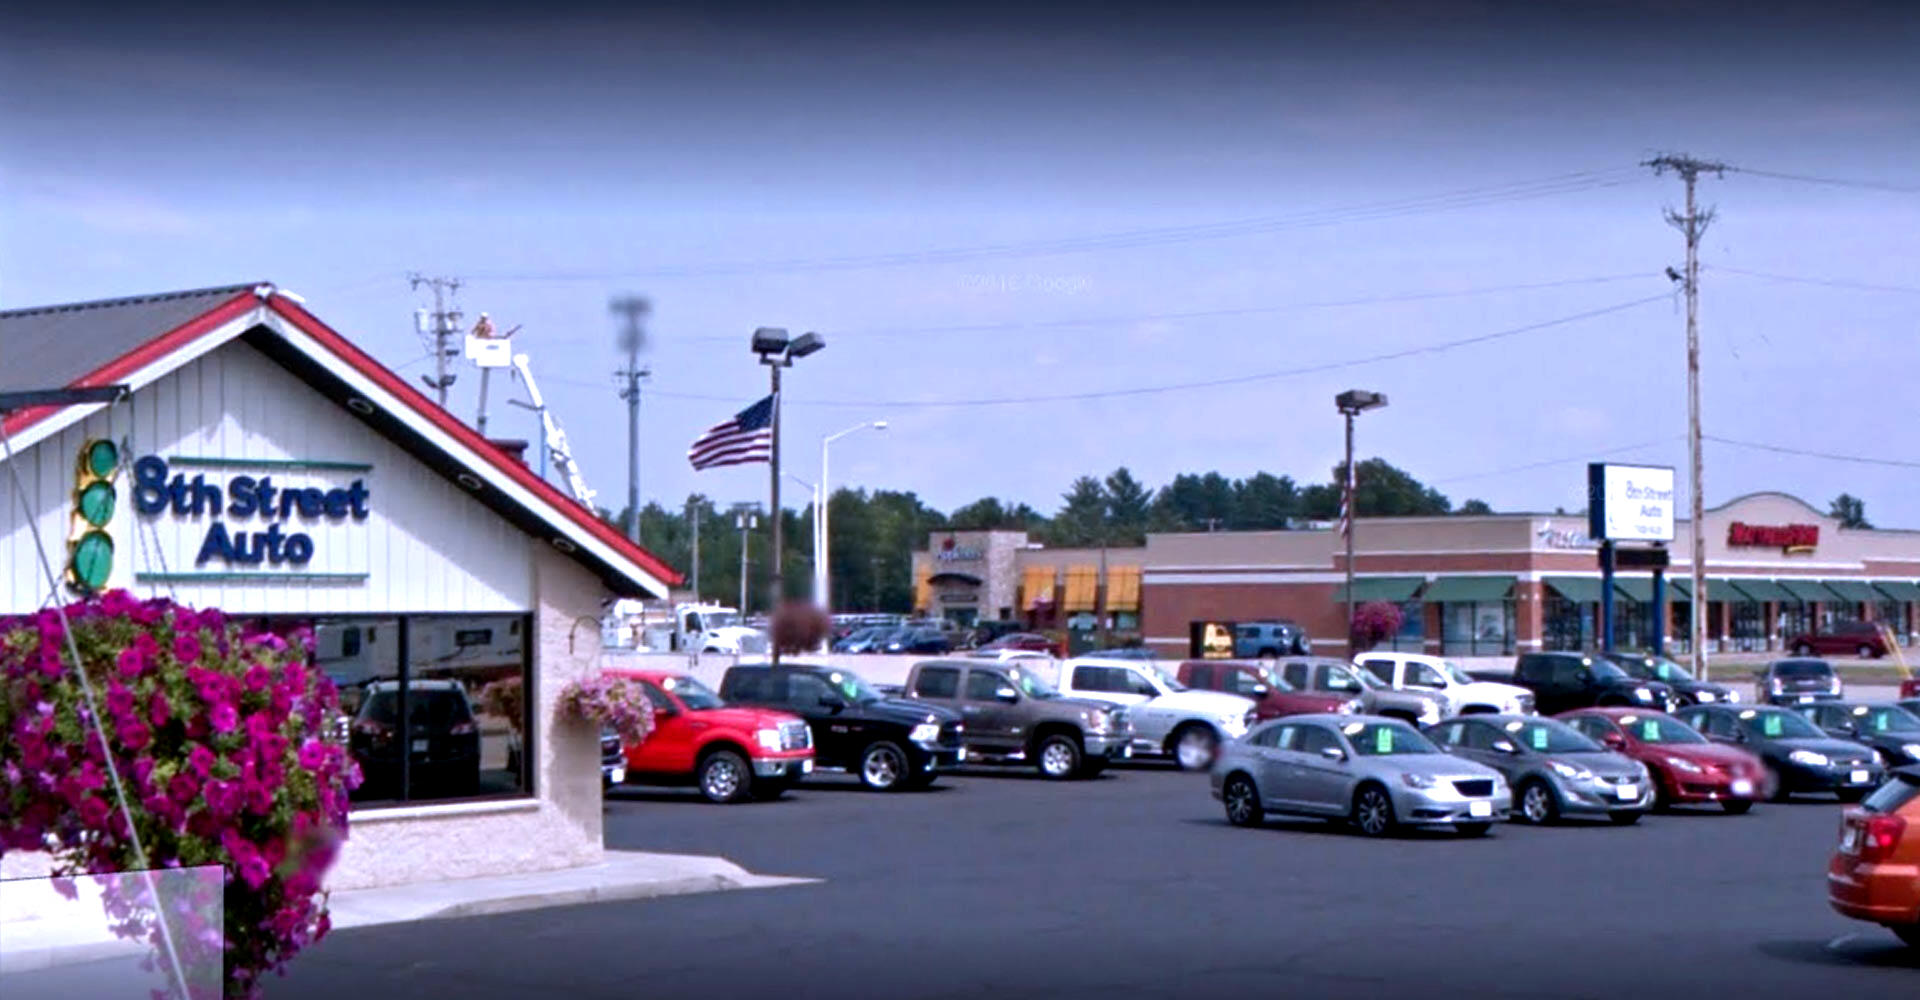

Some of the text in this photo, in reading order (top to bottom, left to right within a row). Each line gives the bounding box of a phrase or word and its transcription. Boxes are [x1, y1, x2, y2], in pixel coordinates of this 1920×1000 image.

[132, 454, 370, 520] 8th Street
[1644, 486, 1673, 501] Street
[1640, 504, 1663, 518] Auto
[195, 522, 315, 566] Auto
